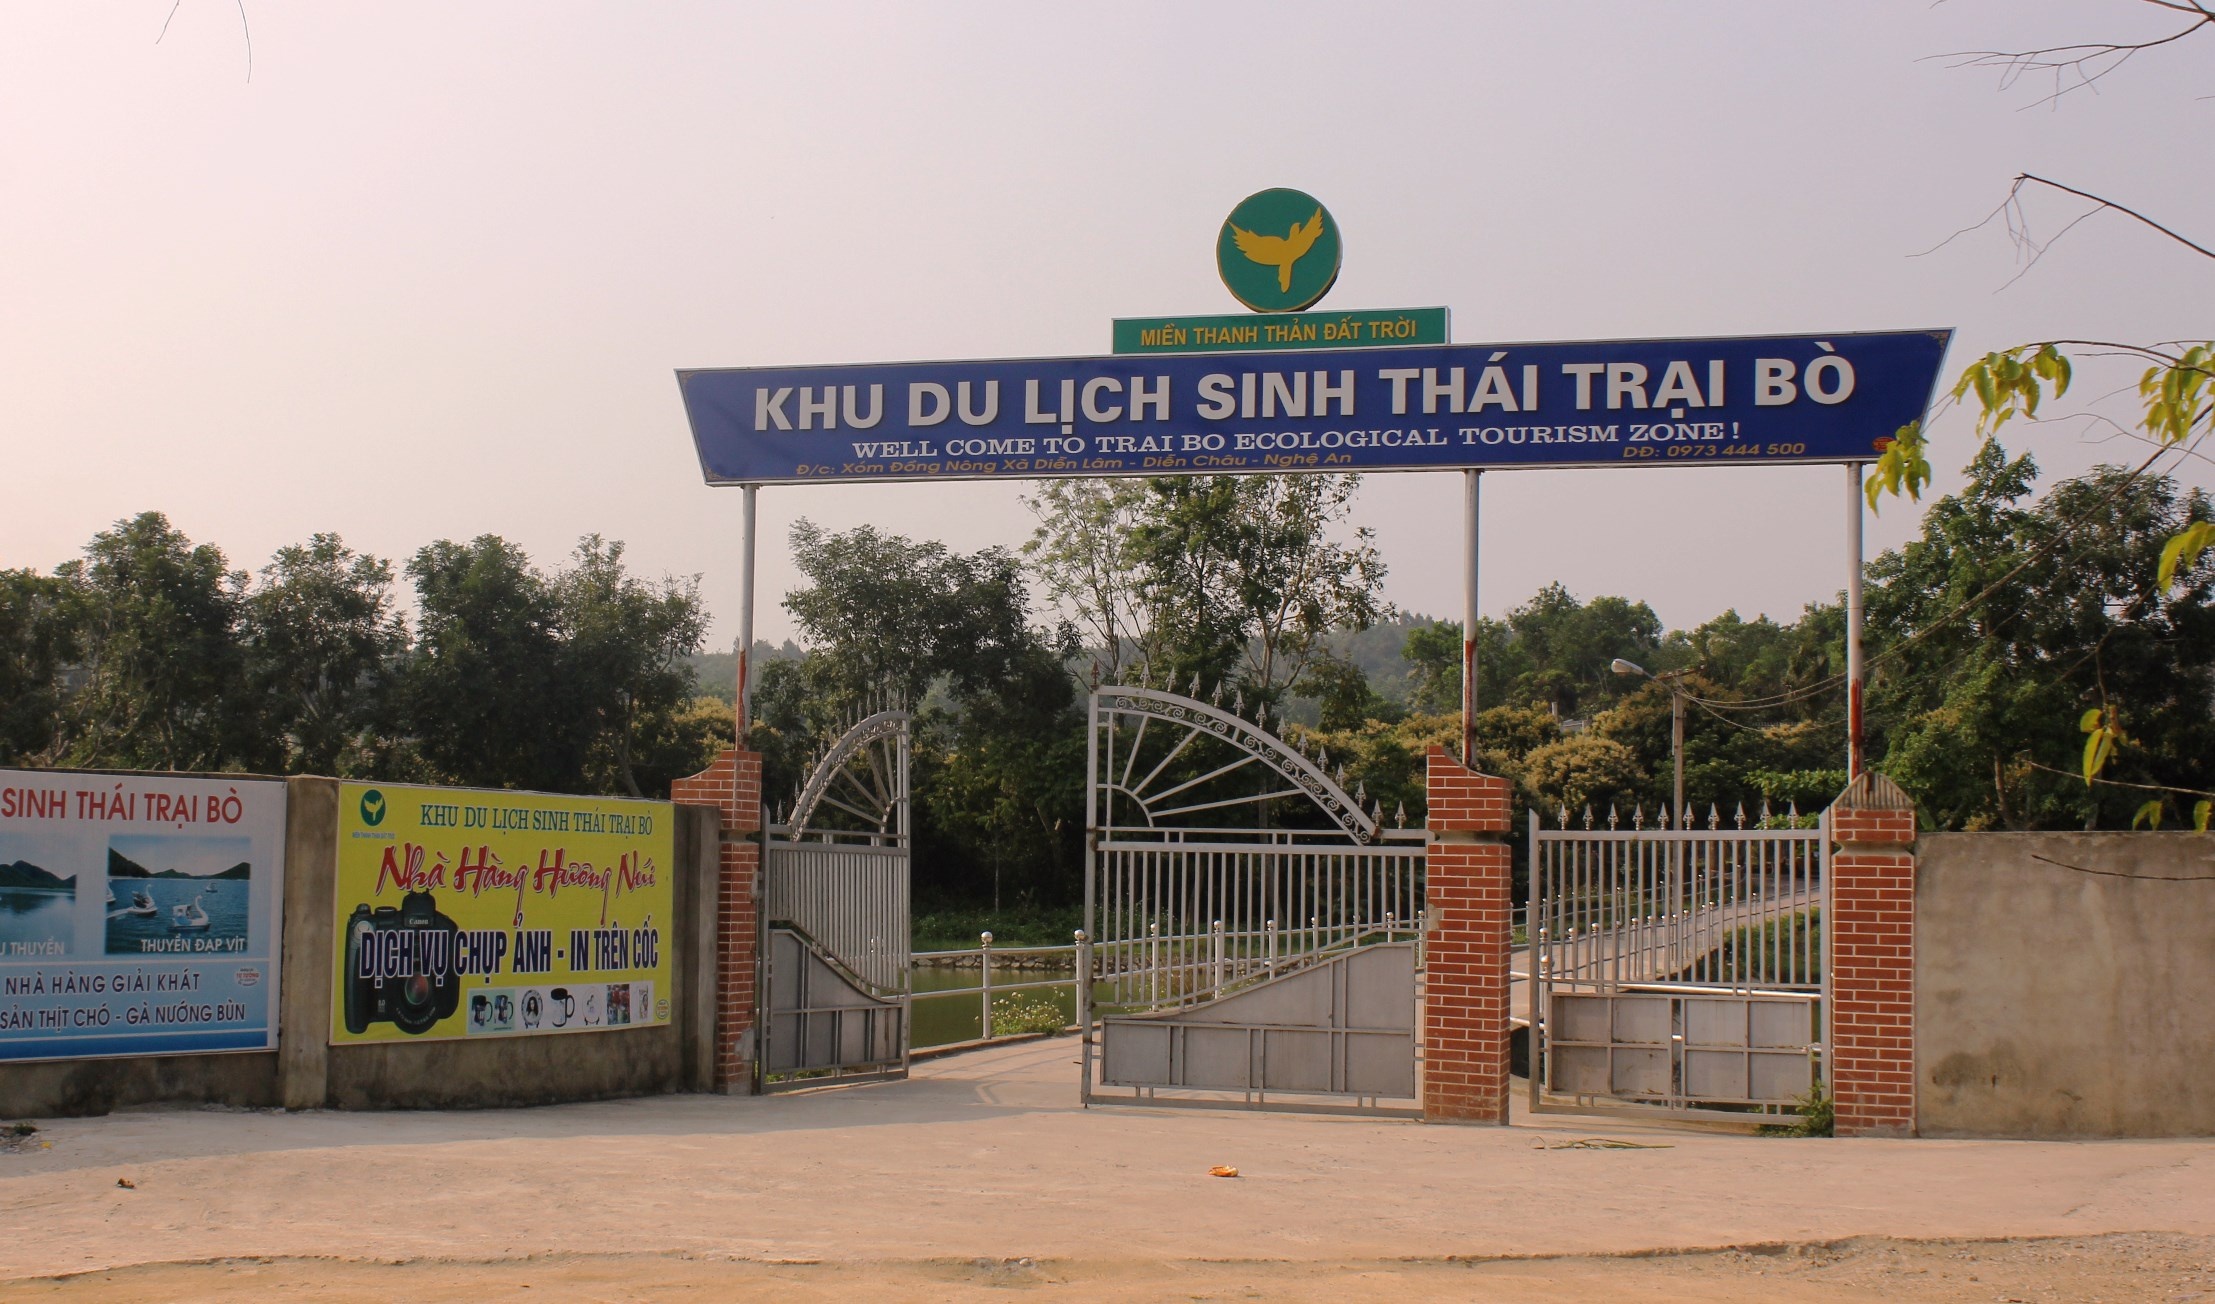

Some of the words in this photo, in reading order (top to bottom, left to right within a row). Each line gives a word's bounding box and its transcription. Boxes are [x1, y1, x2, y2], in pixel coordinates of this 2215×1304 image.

[1141, 322, 1187, 346] MIỀN
[1193, 326, 1258, 344] THANH
[1264, 318, 1316, 342] THẢN
[1323, 316, 1362, 340] ĐẤT
[1368, 316, 1416, 339] TRỜI
[754, 383, 883, 431] KHU
[908, 380, 999, 427] DU
[1025, 375, 1170, 435] LỊCH
[1196, 369, 1354, 421] SINH
[1379, 352, 1538, 415] THÁI
[1561, 360, 1725, 418] TRẠI
[1754, 341, 1855, 406] BÒ
[852, 440, 937, 458] WELL
[945, 438, 1035, 456] COME
[1043, 437, 1085, 454] TO
[1095, 435, 1173, 453] TRAI
[1181, 434, 1225, 451] BO
[1234, 428, 1447, 450] ECOLOGICAL
[1459, 425, 1619, 445] TOURISM
[1667, 445, 1716, 457] 0973
[1722, 444, 1760, 456] 444
[1766, 442, 1805, 454] 500
[841, 461, 884, 474] Xóm
[945, 460, 996, 473] Nông
[1002, 458, 1028, 470] Xã
[1082, 458, 1122, 469] Lâm
[1192, 455, 1247, 467] Châu
[1263, 453, 1318, 468] Nghệ
[1323, 453, 1352, 464] An
[1, 787, 67, 819] SINH
[76, 782, 135, 821] THÁI
[144, 793, 198, 829] TRẠI
[206, 787, 243, 824] BÒ
[420, 804, 458, 827] KHU
[464, 806, 487, 828] DU
[492, 808, 529, 835] LỊCH
[533, 810, 570, 832] SINH
[573, 807, 605, 834] THÁI
[609, 815, 635, 839] TRẠI
[638, 810, 653, 836] BÒ
[375, 842, 450, 896] Nhà
[453, 845, 530, 927] Hàng
[615, 850, 656, 899] Núi
[195, 938, 222, 954] ĐẠP
[359, 930, 414, 988] DỊCH
[419, 930, 449, 987] VỤ
[454, 930, 507, 984] CHỤP
[512, 912, 552, 973] ẢNH
[570, 929, 589, 971] IN
[593, 920, 629, 970] TRÊN
[632, 914, 659, 969] CỐC
[5, 971, 45, 995] NHÀ
[52, 970, 105, 993] HÀNG
[112, 968, 151, 993] GIẢI
[157, 968, 200, 991] KHÁT
[0, 1004, 33, 1029] SẢN
[39, 1006, 69, 1031] THỊT
[74, 1003, 110, 1026] CHÓ
[126, 1001, 150, 1024] GÀ
[155, 1000, 212, 1023] NƯỚNG
[217, 999, 245, 1021] BÙN
